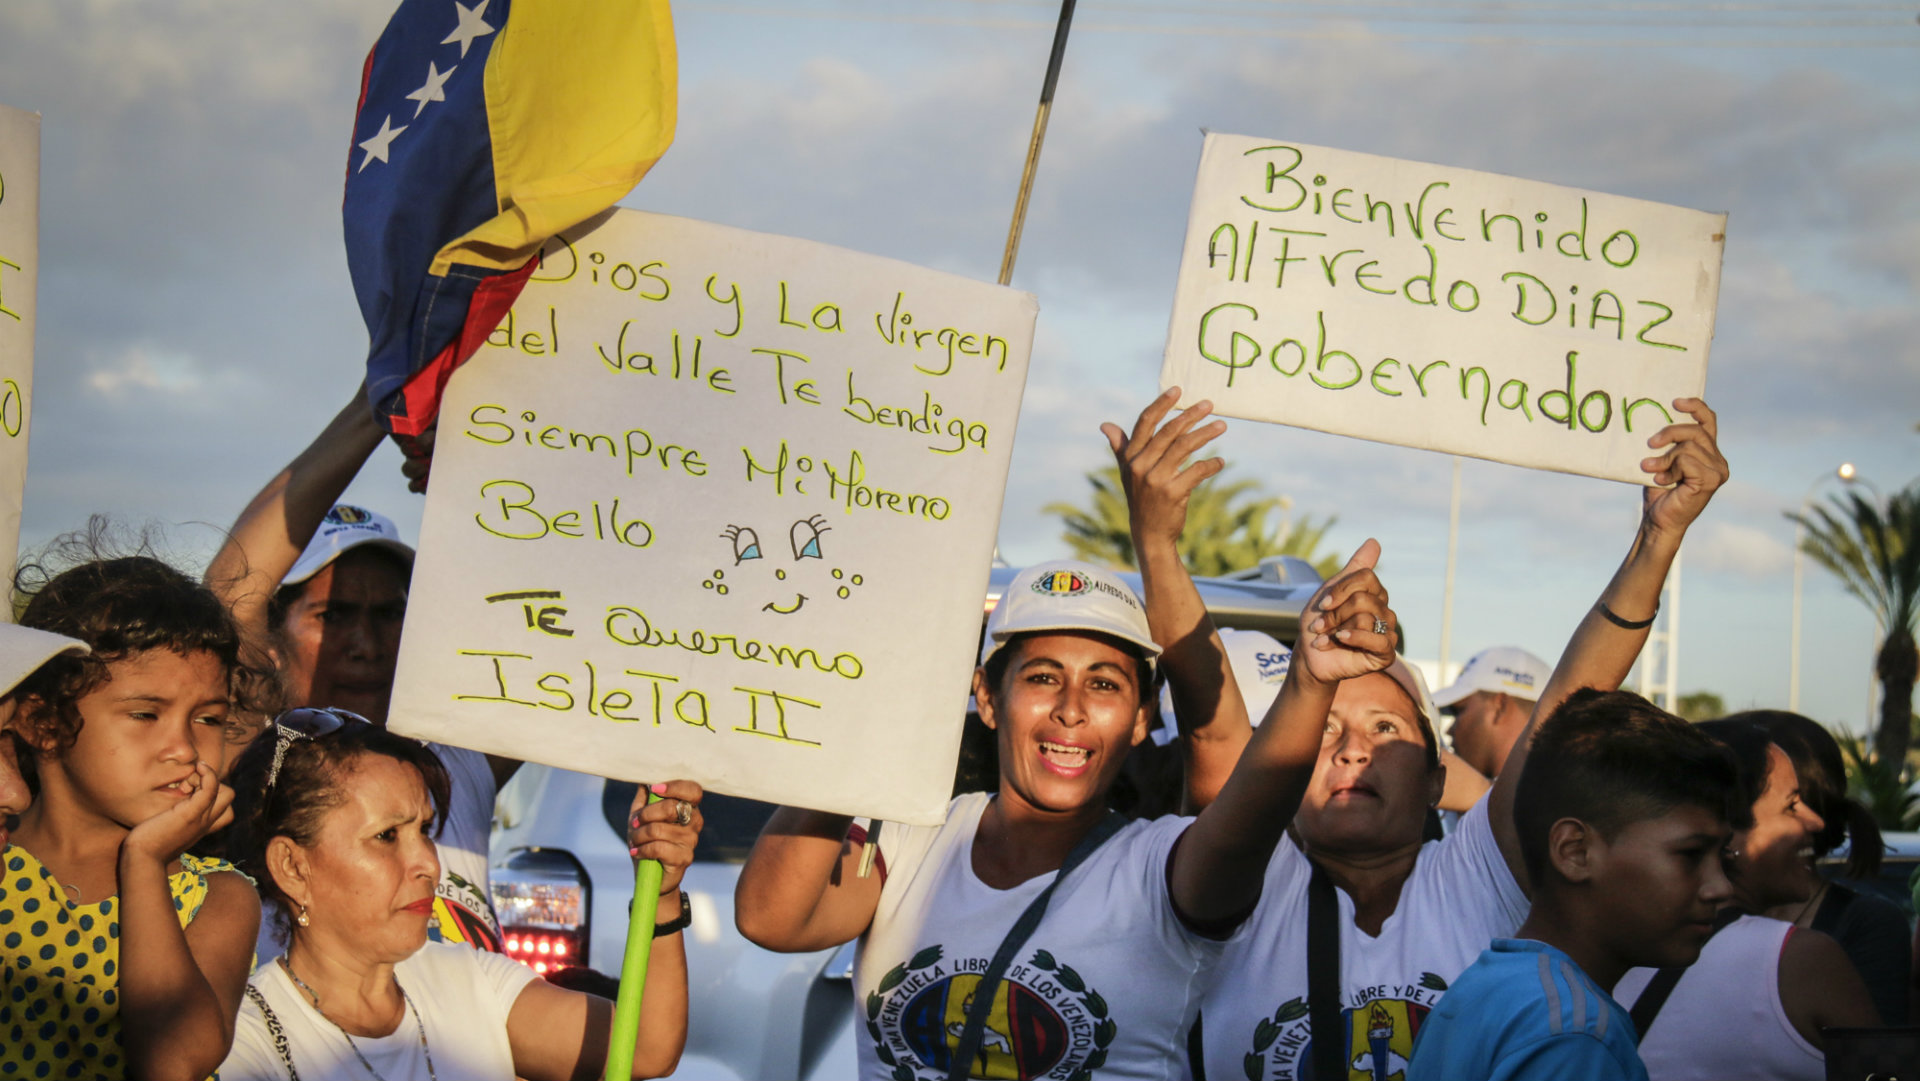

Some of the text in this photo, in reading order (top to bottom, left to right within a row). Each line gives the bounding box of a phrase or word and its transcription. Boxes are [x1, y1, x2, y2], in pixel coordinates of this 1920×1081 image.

[1240, 145, 1639, 268] Bienvenido
[529, 233, 671, 301] Dios
[780, 281, 844, 333] La
[485, 308, 559, 355] del
[844, 371, 988, 453] bendiga
[464, 405, 707, 478] Siempre
[475, 480, 655, 548] Bello
[605, 606, 865, 681] Queremo
[438, 883, 481, 913] DE LOS
[881, 965, 945, 1029] VENEZUELA
[954, 958, 989, 973] LIBR
[1010, 964, 1031, 980] DE
[1028, 974, 1063, 1000] LOS
[1350, 984, 1387, 1007] LIBRE
[1393, 985, 1403, 997] Y
[1404, 984, 1424, 1002] DE
